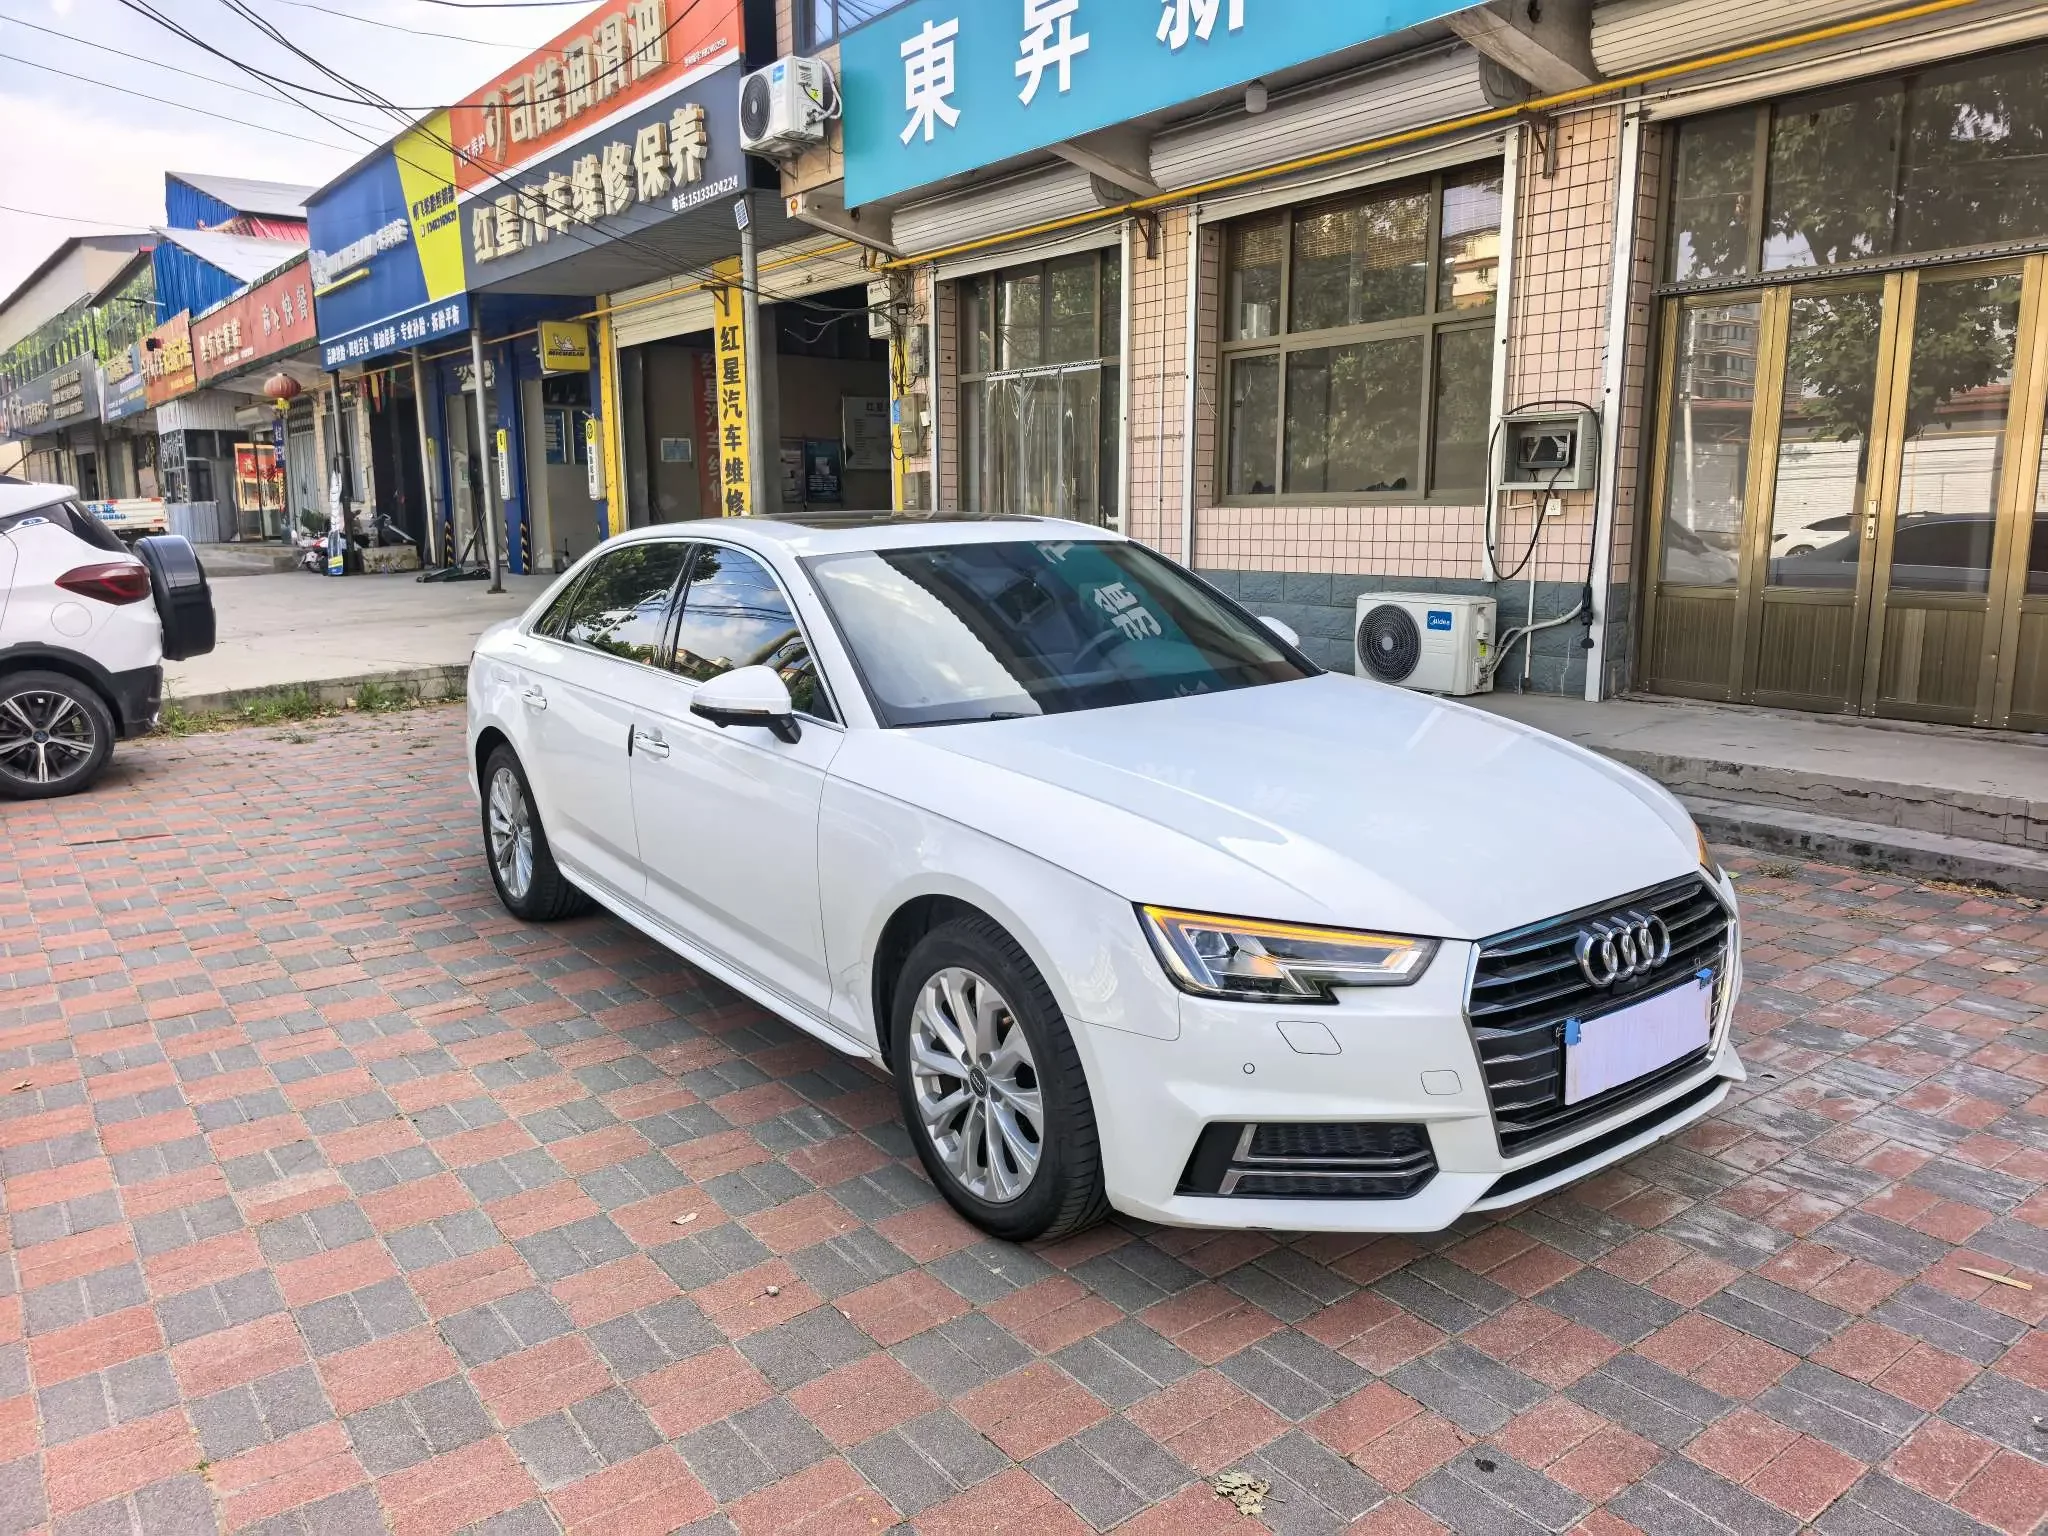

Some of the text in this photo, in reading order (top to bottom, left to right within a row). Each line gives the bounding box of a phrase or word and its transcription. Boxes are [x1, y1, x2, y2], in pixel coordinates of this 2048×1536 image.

[472, 103, 708, 264] 红星汽车维修保养
[671, 174, 738, 212] 电话:15133124224
[720, 326, 746, 517] 红星汽车维修
